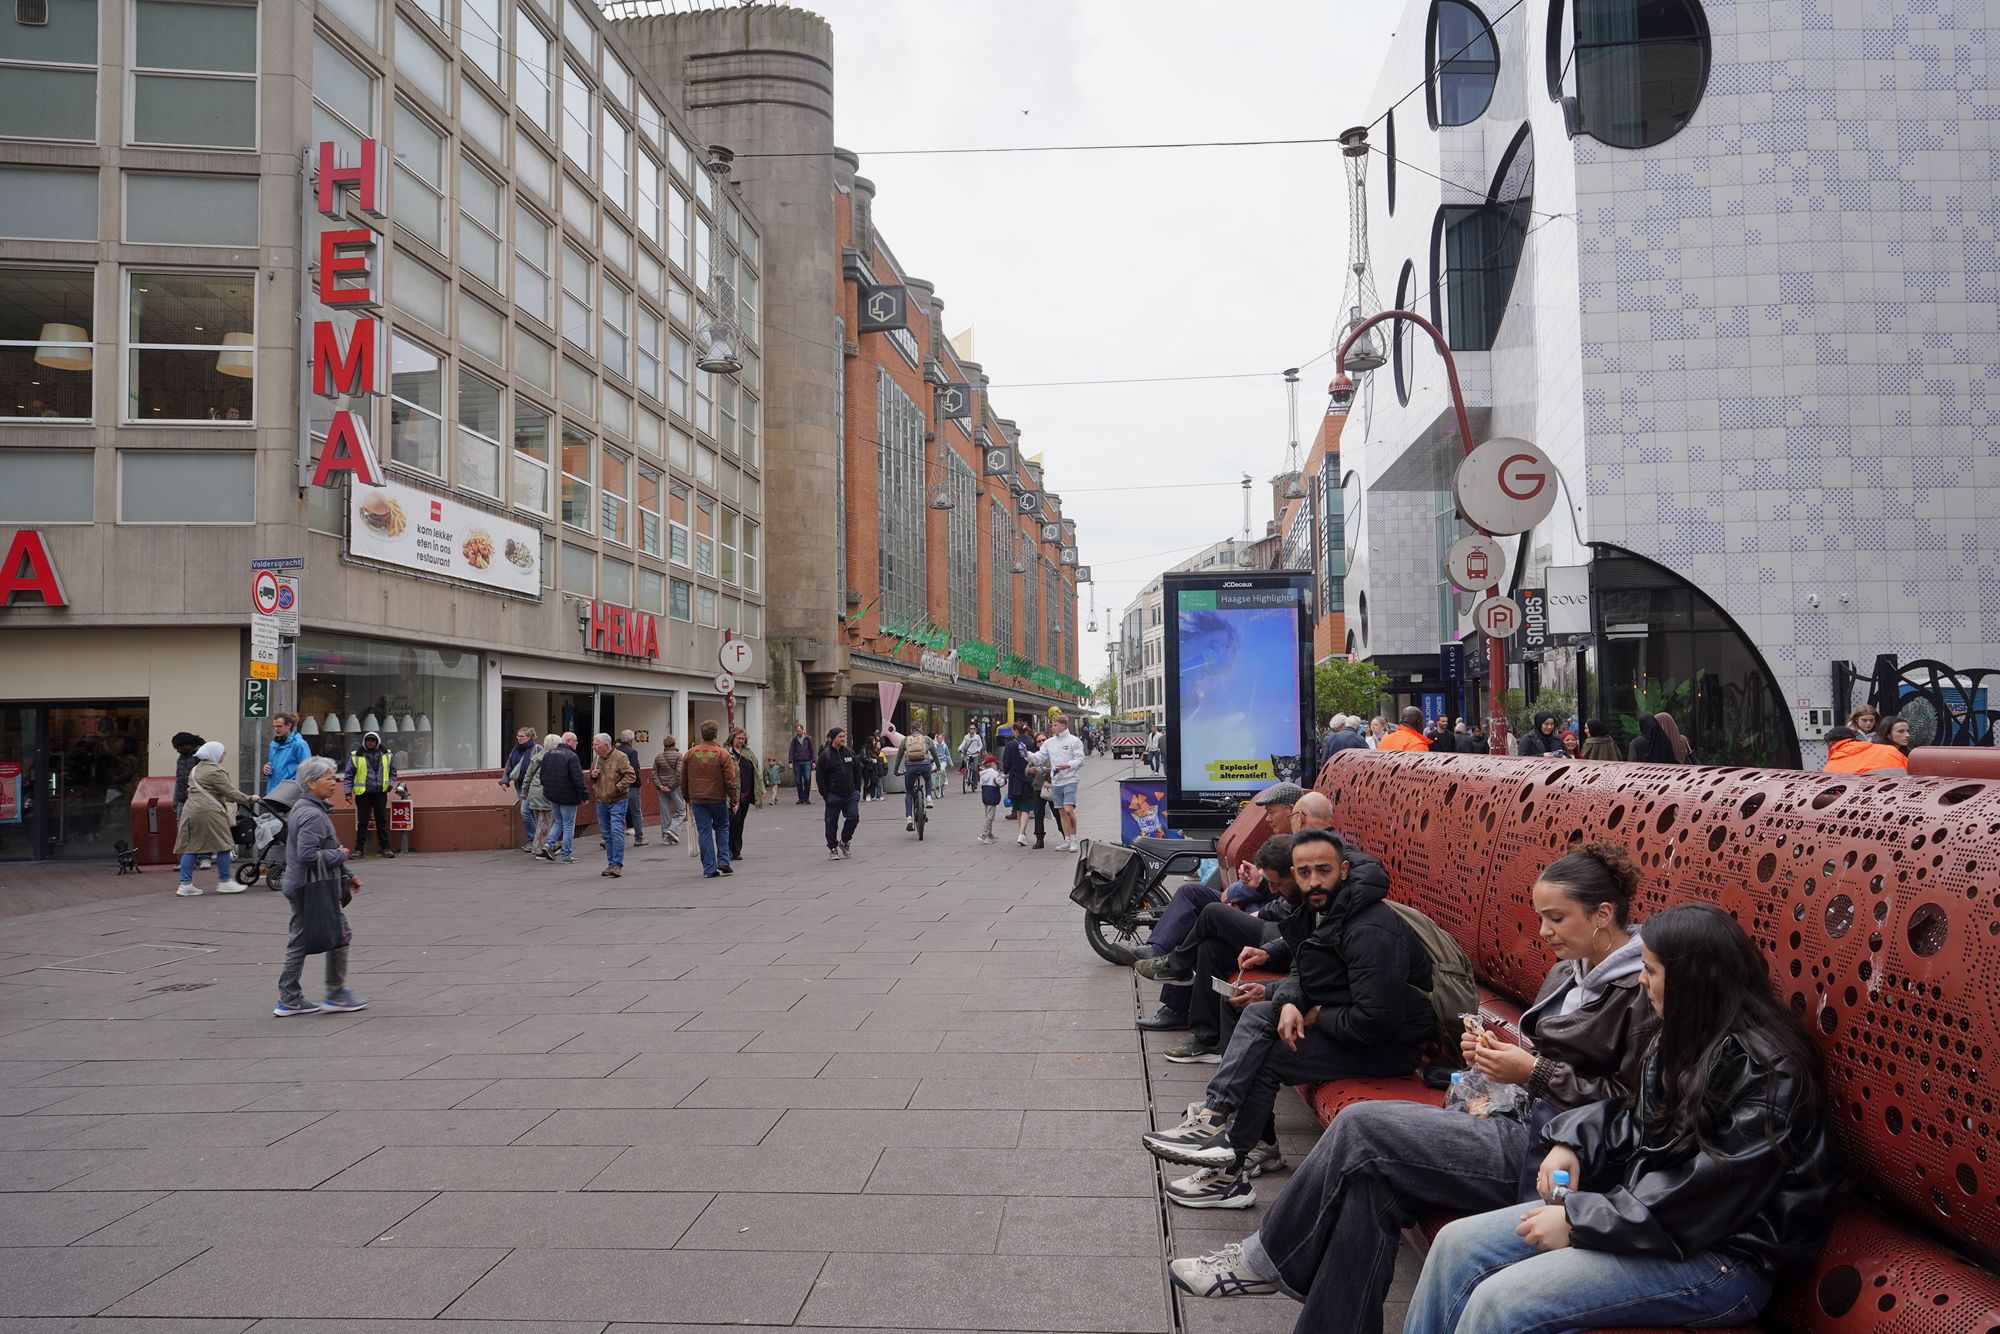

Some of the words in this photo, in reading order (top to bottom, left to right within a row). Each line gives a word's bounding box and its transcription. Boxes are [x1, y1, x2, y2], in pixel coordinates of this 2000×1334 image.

[311, 138, 387, 489] HEMA
[1497, 453, 1546, 500] G
[416, 523, 432, 536] kom
[433, 527, 453, 541] lekker
[416, 538, 432, 550] eten
[433, 540, 439, 551] in
[440, 544, 451, 555] ons
[252, 559, 302, 569] Voldersgracht
[416, 552, 451, 567] restaurant
[1221, 595, 1251, 604] Haagse
[1252, 594, 1295, 604] Highlights
[1525, 596, 1547, 645] snipes
[591, 600, 660, 660] HEMA
[258, 650, 267, 659] 60
[736, 645, 746, 662] F
[247, 680, 262, 700] P
[1219, 763, 1259, 772] Explosief
